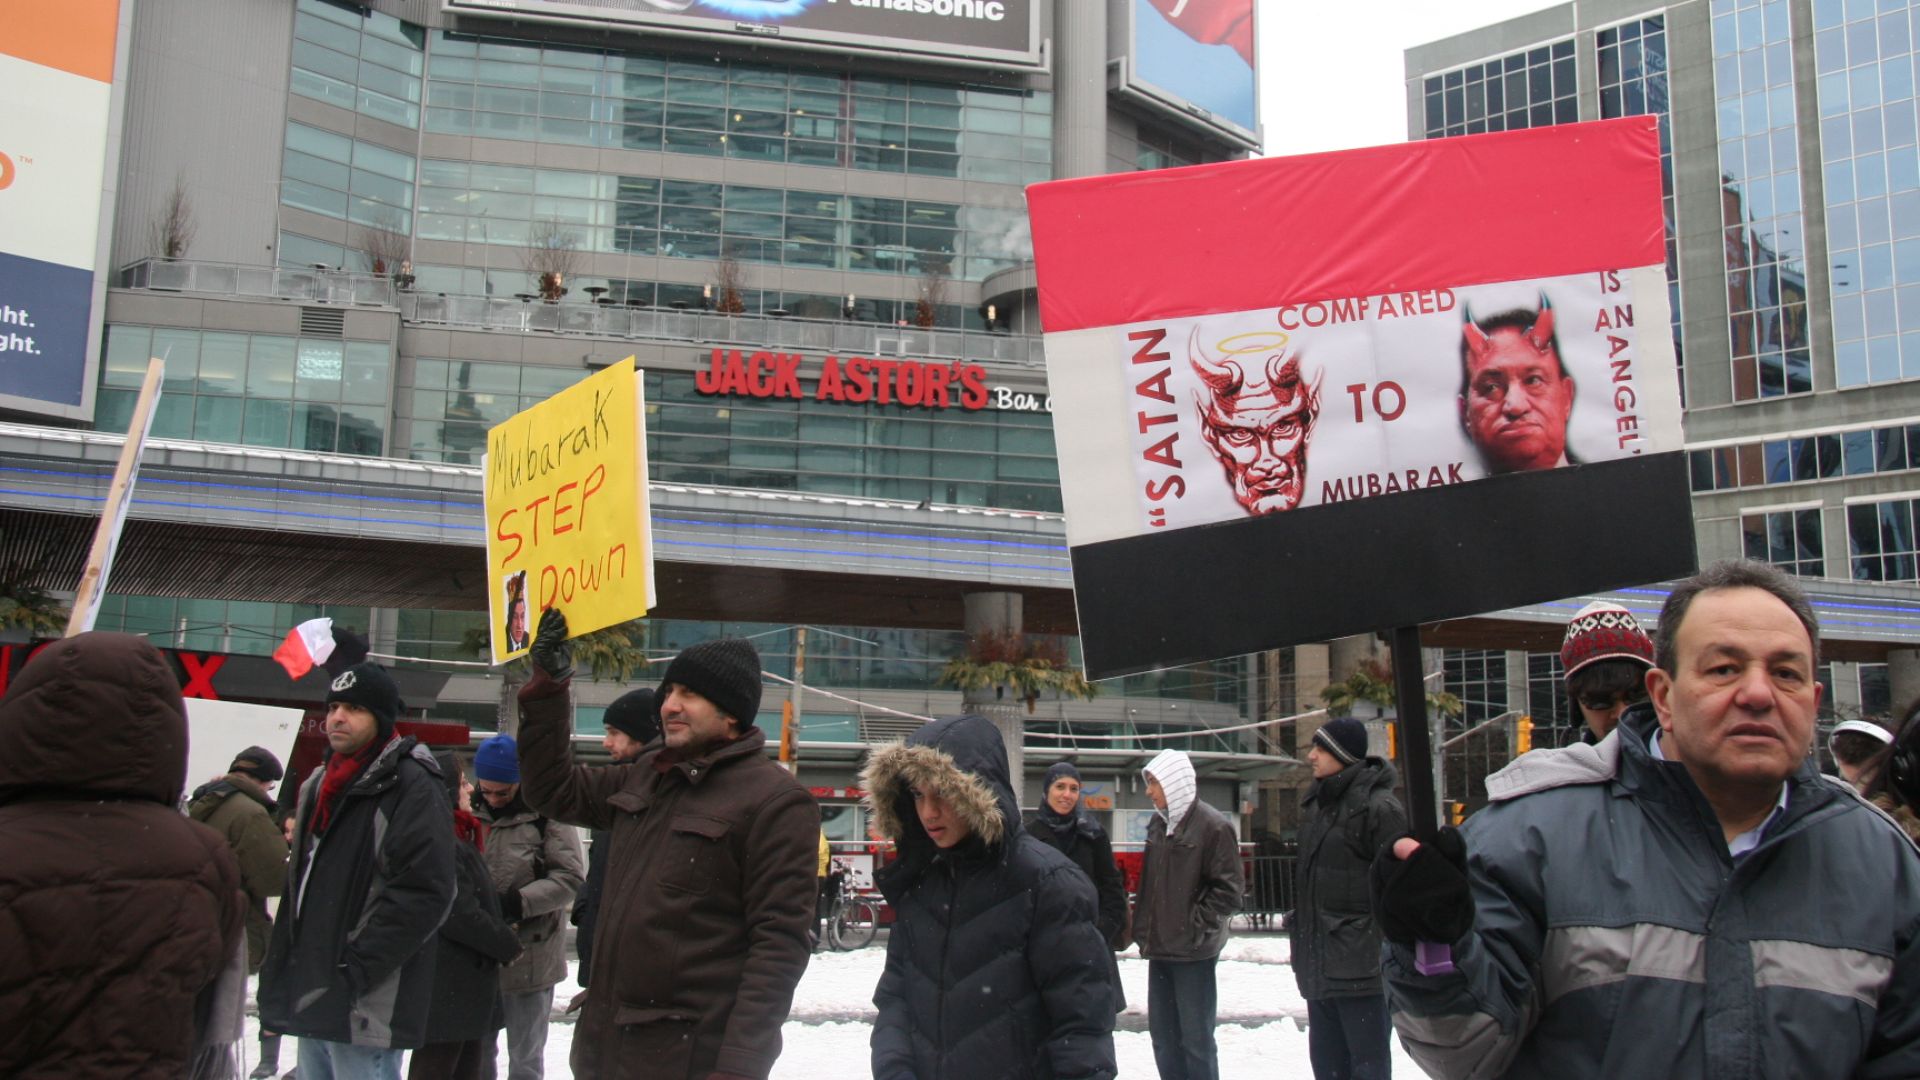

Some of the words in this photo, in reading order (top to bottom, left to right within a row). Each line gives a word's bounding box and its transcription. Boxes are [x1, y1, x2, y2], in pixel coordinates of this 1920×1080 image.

[828, 0, 1005, 21] nasonic
[1600, 269, 1621, 294] IS
[1278, 288, 1456, 331] COMPARED
[1594, 303, 1634, 332] AN
[695, 348, 804, 399] JACK
[816, 355, 989, 410] ASTOR'S
[993, 386, 1039, 411] Bar
[1346, 380, 1407, 423] TO
[1321, 462, 1464, 505] MUBARAK
[496, 463, 606, 569] STEP
